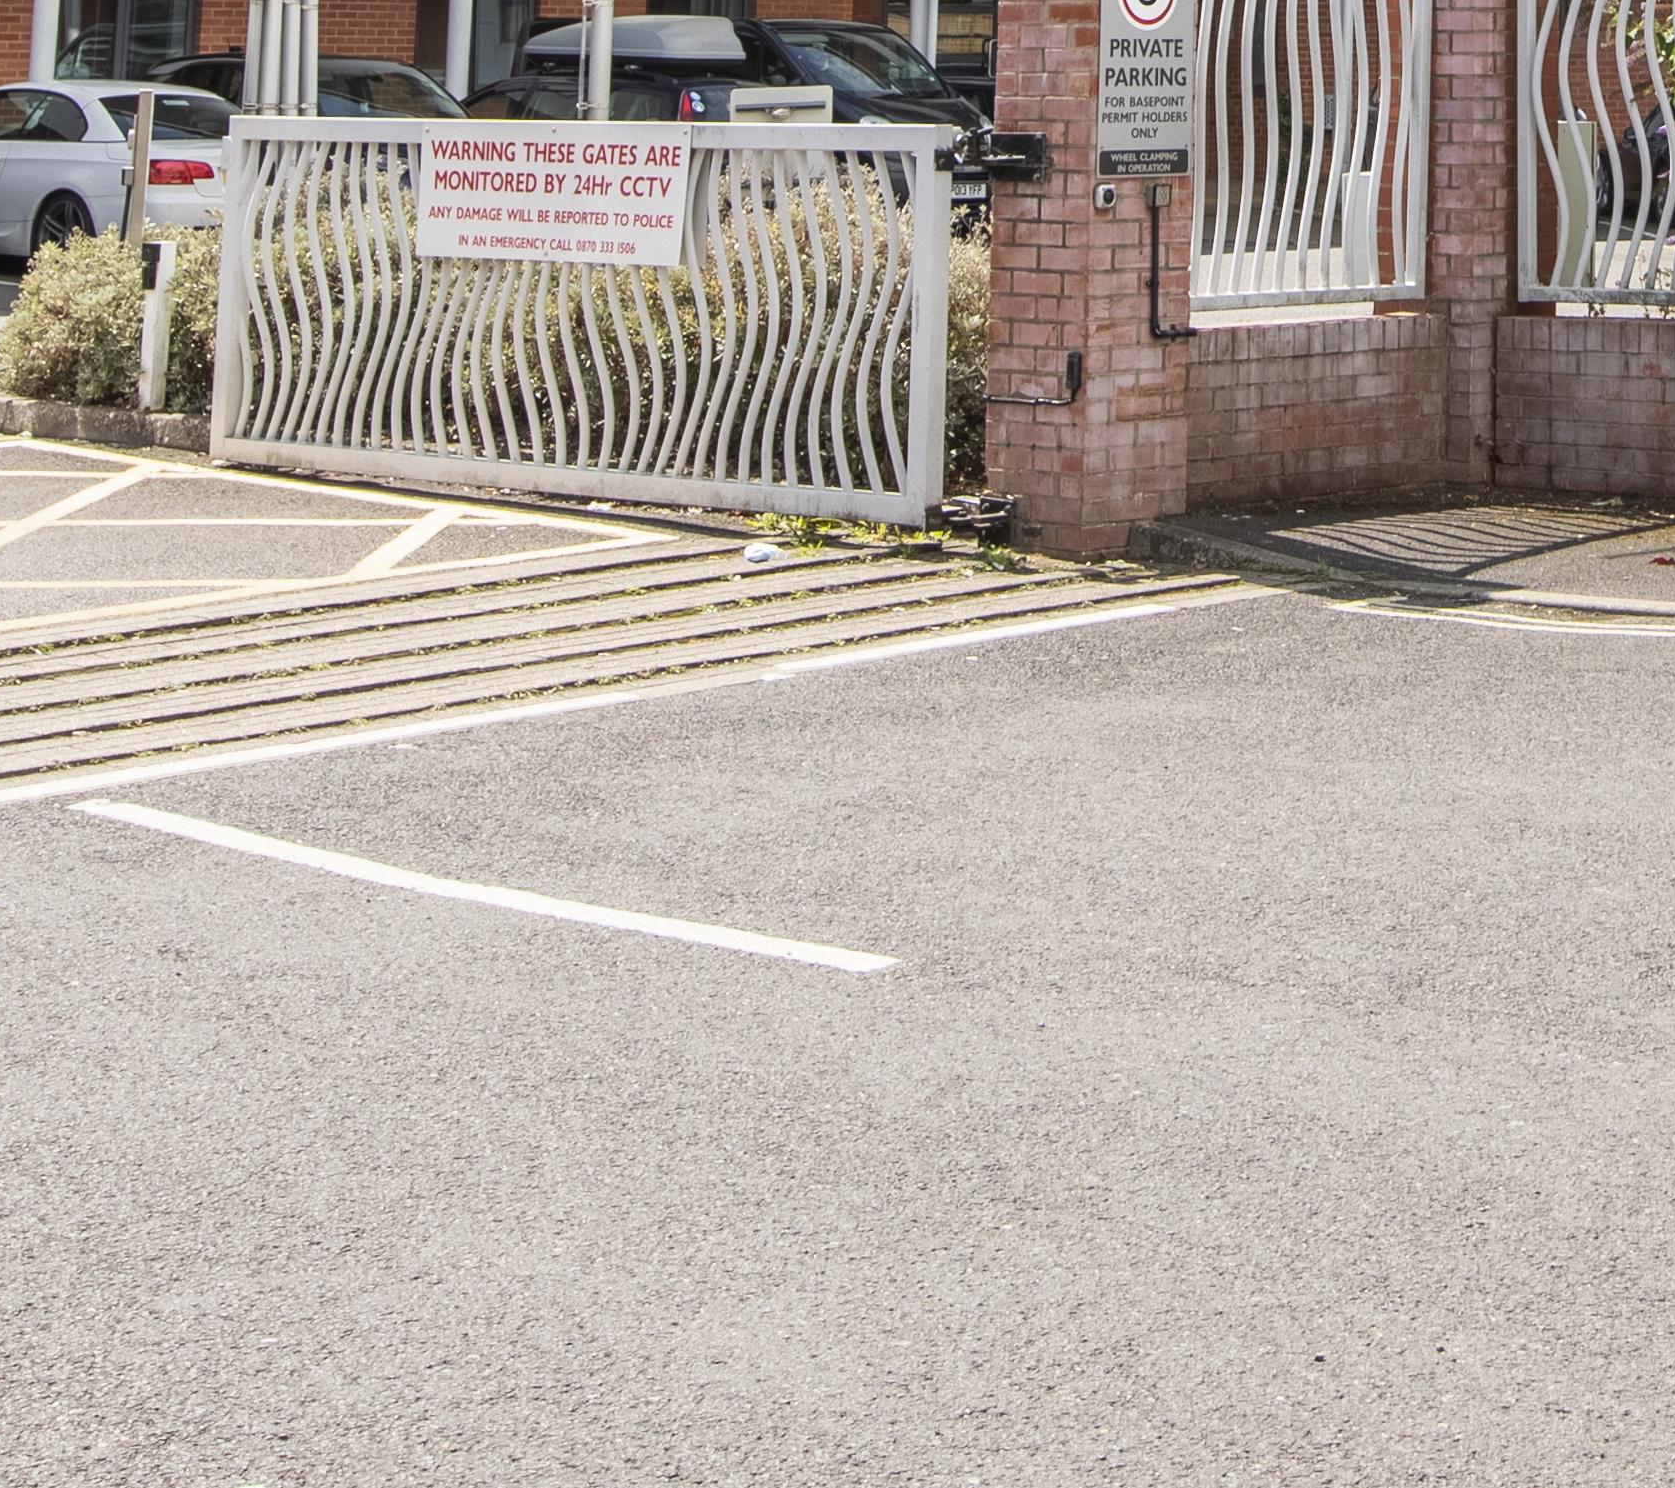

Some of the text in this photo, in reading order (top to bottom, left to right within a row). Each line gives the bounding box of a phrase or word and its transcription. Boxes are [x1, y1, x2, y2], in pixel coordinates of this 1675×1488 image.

[1109, 38, 1184, 58] PRIVATE
[1105, 67, 1187, 87] PARKING
[1104, 95, 1186, 108] FOR BASEPOINT
[1101, 111, 1188, 124] PERMIT HOLDERS
[1131, 127, 1158, 138] ONLY
[431, 140, 682, 167] WARNING THESE GATES ARE
[1110, 151, 1179, 162] WHEEL CLAMPING
[1117, 163, 1172, 173] IN OPERATION
[433, 170, 673, 198] MONITORED BY 24Hr CCTV
[428, 205, 674, 229] ANY DAMAGE WILL BE REPORTED TO POLICE
[458, 234, 636, 254] IN AN EMERGENCY CALL 0870 333 1506
